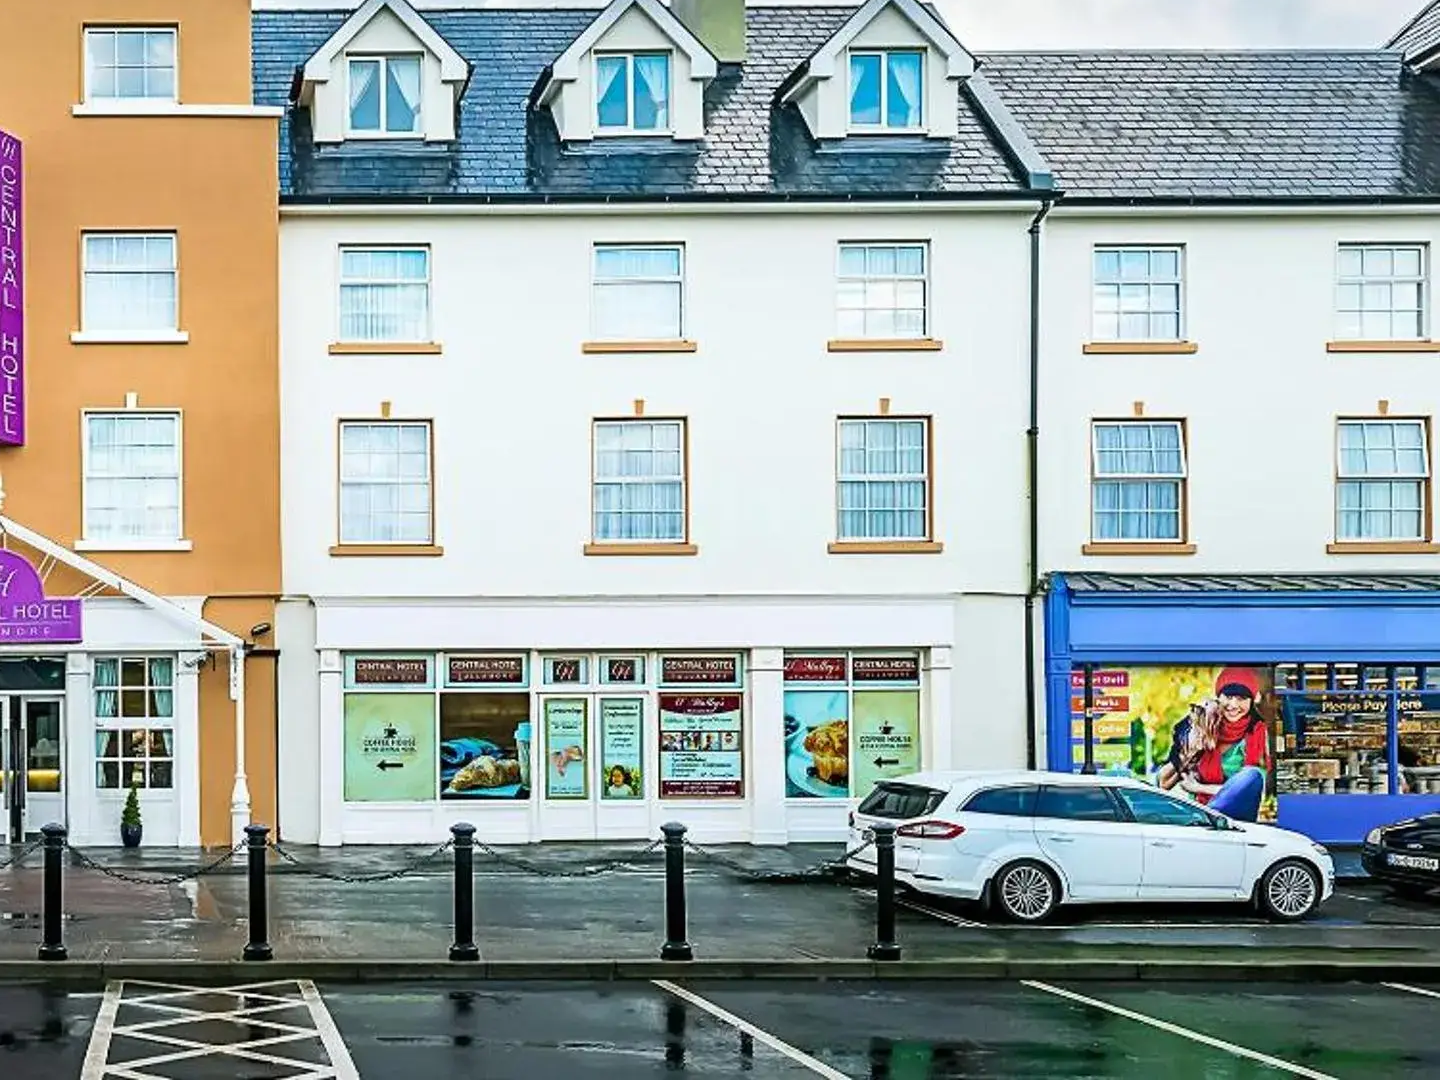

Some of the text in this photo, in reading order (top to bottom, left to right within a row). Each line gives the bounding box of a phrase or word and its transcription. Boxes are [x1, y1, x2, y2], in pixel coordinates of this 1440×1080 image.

[0, 165, 18, 436] CENTRAL HOTEL
[12, 603, 73, 620] HOTEL
[357, 662, 425, 671] CENTRAL HOTEL
[451, 661, 521, 671] CENTRAL HOTEL
[664, 659, 735, 670] CENTRAL HOTEL
[854, 660, 916, 669] CENTRAL HOTEL
[1321, 700, 1361, 712] Please
[1363, 699, 1388, 713] Pay
